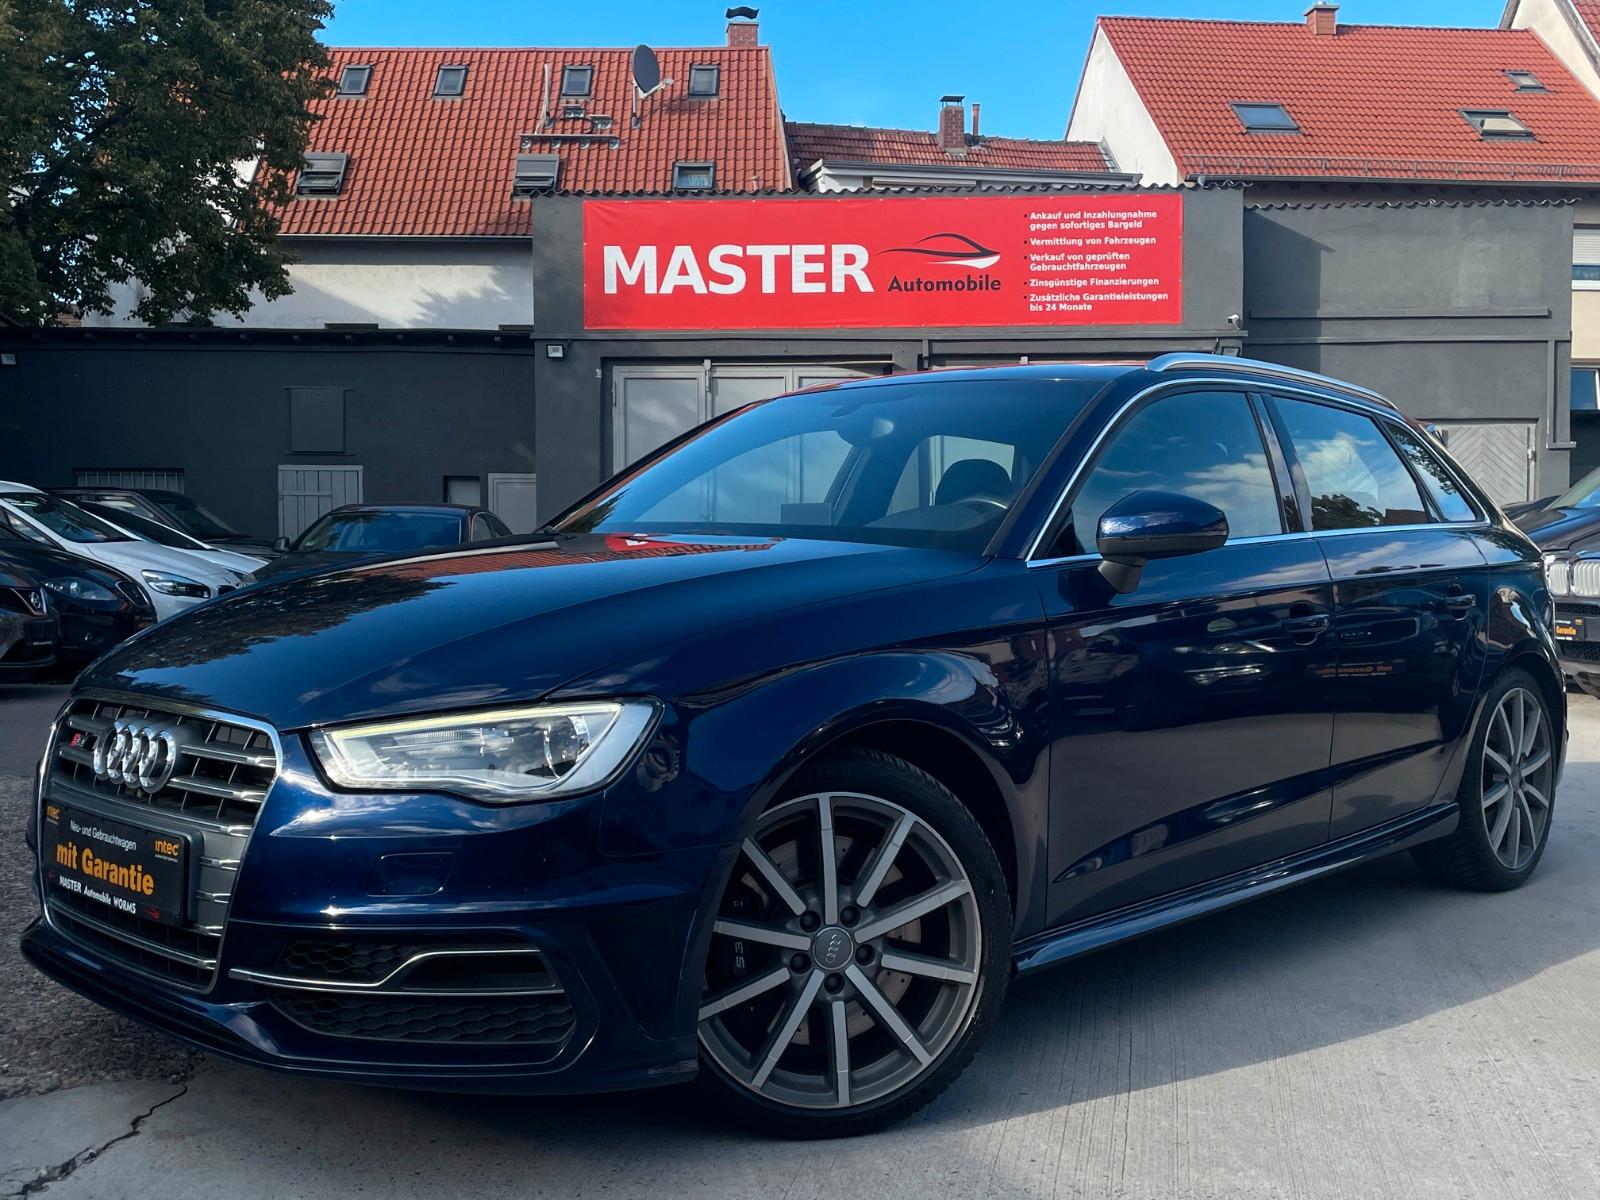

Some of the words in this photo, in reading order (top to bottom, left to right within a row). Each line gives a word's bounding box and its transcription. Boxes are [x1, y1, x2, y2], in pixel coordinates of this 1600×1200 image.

[1030, 211, 1062, 219] Ankauf
[1064, 211, 1081, 219] und
[1083, 210, 1157, 221] Inzahlungnahme
[1030, 222, 1058, 231] gegen
[1060, 221, 1106, 230] sofortiges
[1108, 220, 1143, 230] Bargeld
[1030, 237, 1083, 246] Vermittlung
[1104, 236, 1157, 246] Fahrzeugen
[1030, 253, 1065, 261] Verkauf
[1086, 252, 1130, 262] geprüften
[603, 244, 875, 294] MASTER
[1030, 262, 1127, 272] Gebrauchtfahrzeugen
[887, 275, 1001, 293] Automobile
[1030, 278, 1088, 288] Zinsgünstige
[1090, 277, 1160, 287] Finanzierungen
[1030, 293, 1081, 302] Zusätzliche
[1083, 292, 1169, 302] Garantieleistungen
[1029, 303, 1043, 311] bis
[1045, 303, 1057, 311] 24
[1059, 303, 1093, 311] Monate
[70, 820, 82, 833] Neu-
[82, 826, 92, 837] und
[92, 827, 137, 851] Gebrauchtwagen
[155, 840, 179, 856] intec
[56, 842, 78, 869] mit
[81, 848, 154, 895] Garantie
[59, 875, 82, 894] MASTER
[83, 885, 112, 905] Automobile
[113, 895, 136, 914] WORMS
[735, 941, 745, 969] S3
